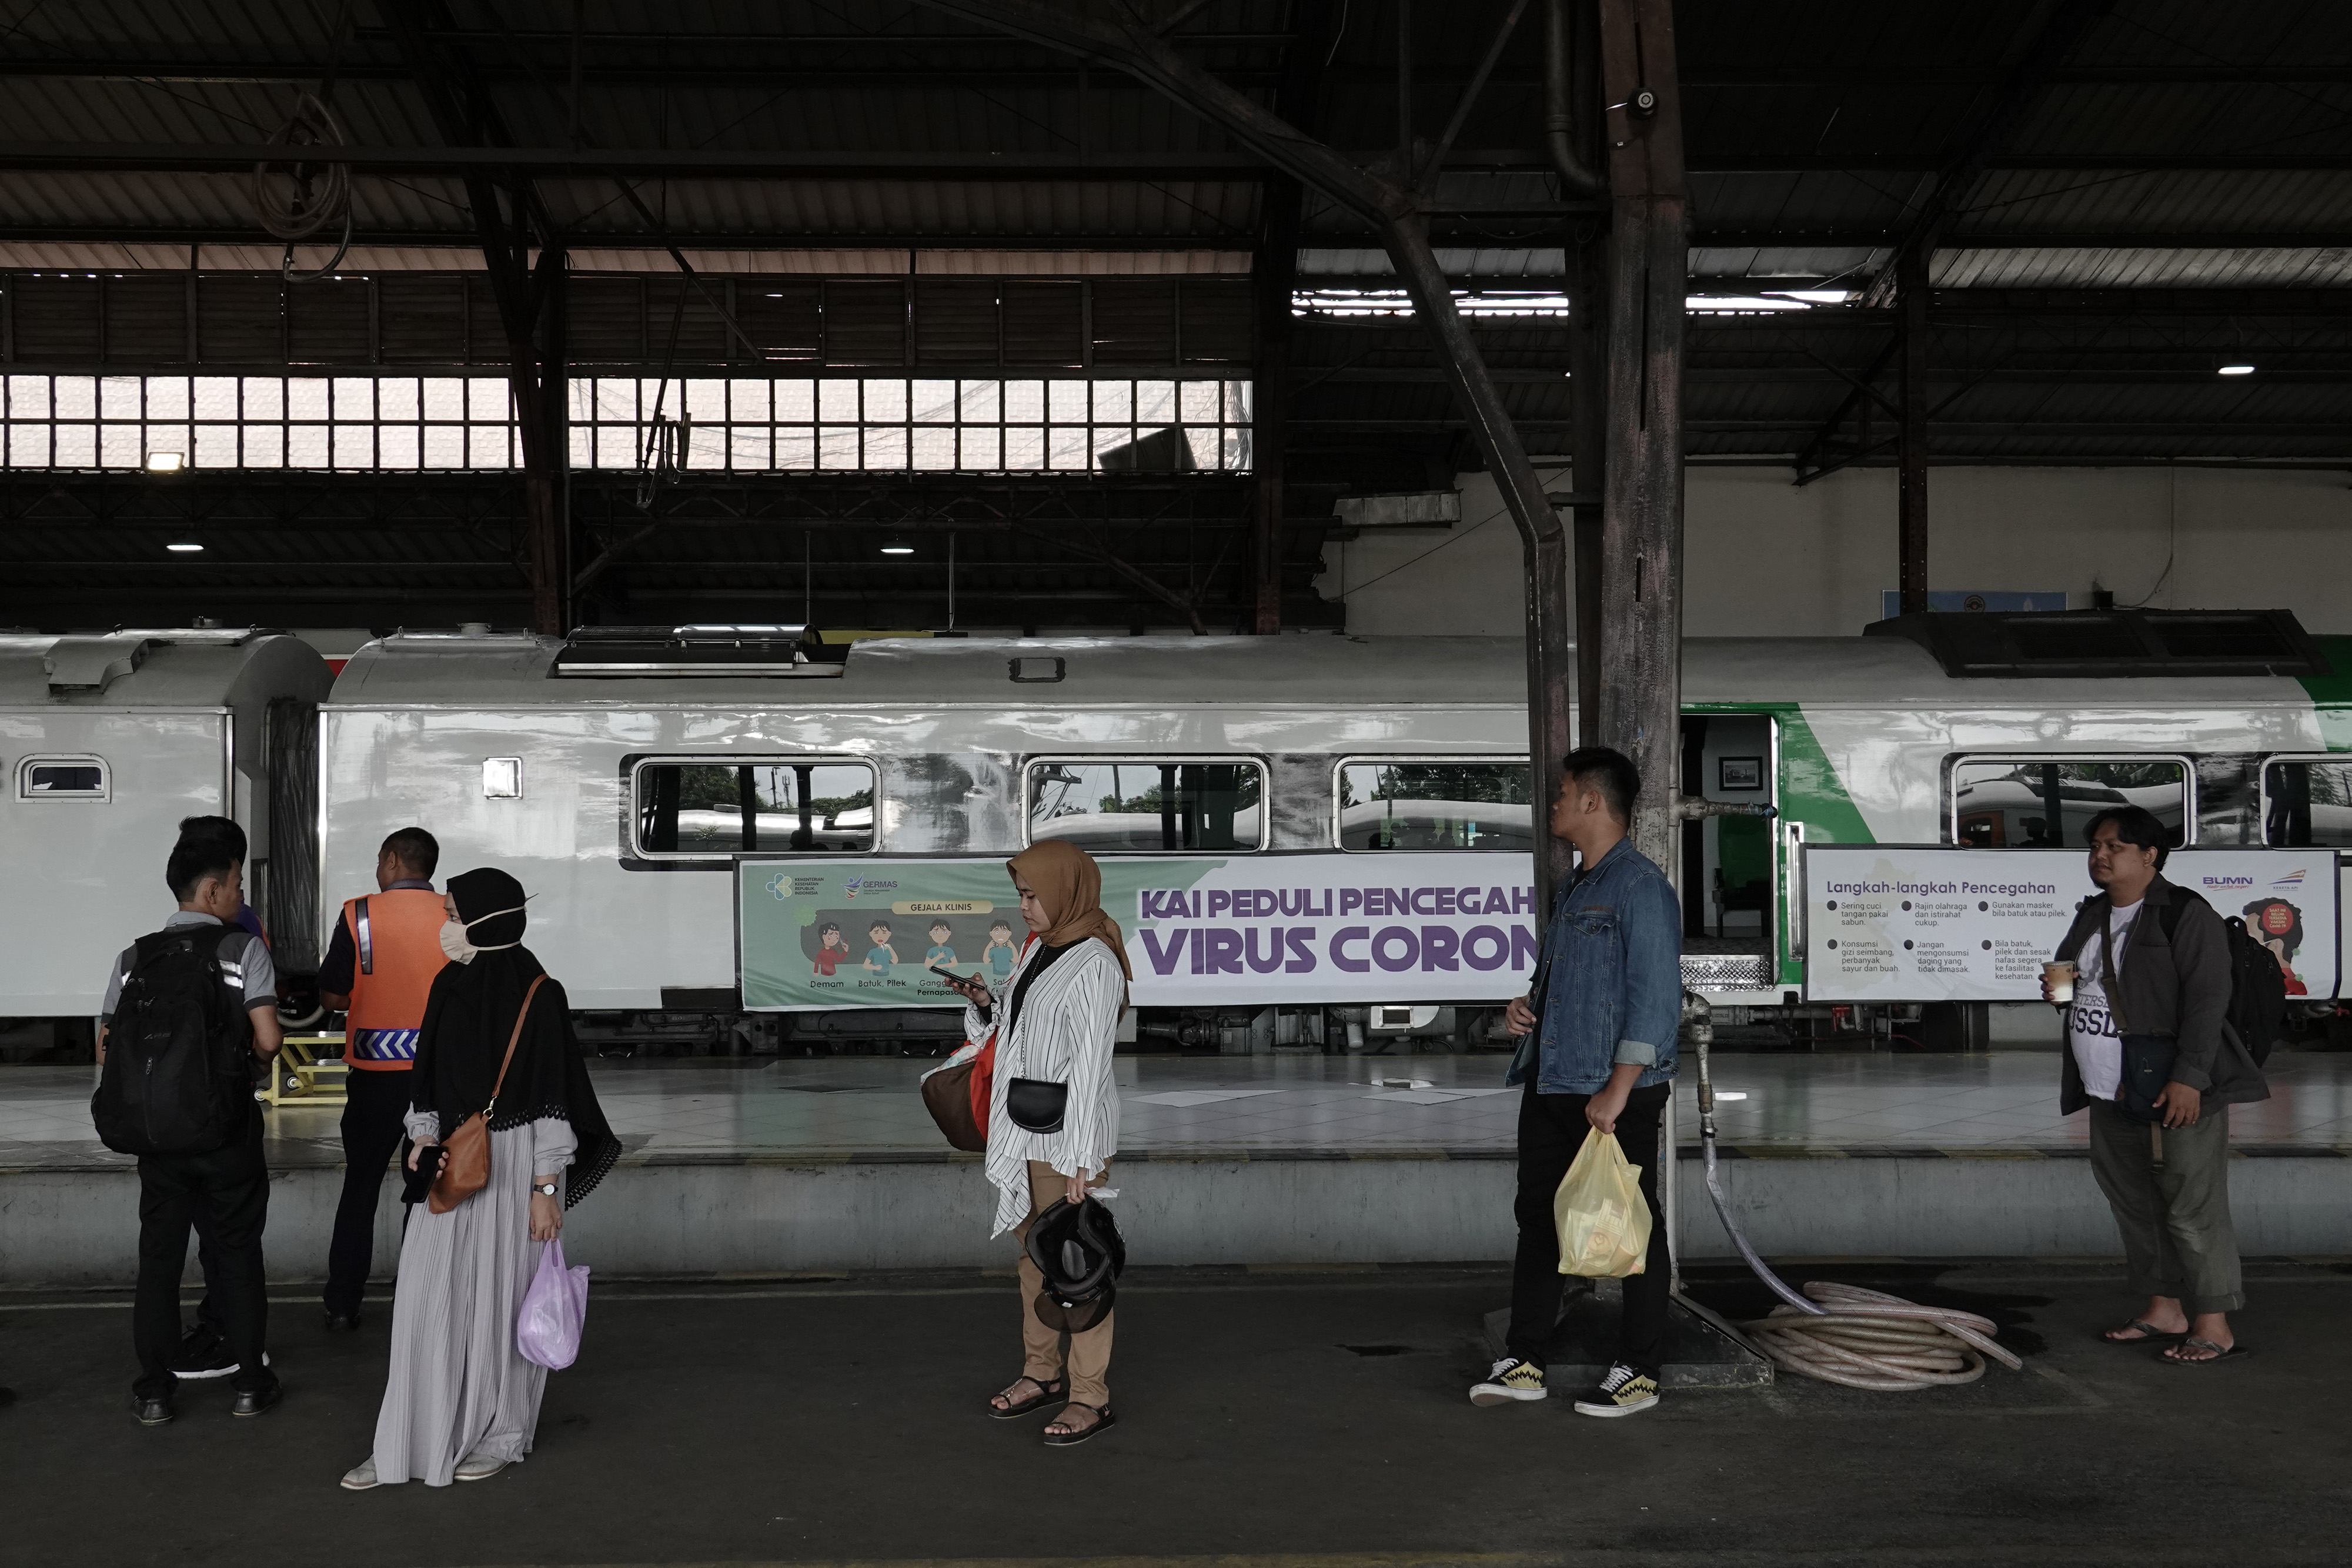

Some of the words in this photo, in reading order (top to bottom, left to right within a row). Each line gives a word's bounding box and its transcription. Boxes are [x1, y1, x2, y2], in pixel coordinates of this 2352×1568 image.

[1828, 881, 1956, 896] Langkah-langkah
[1962, 882, 2054, 896] Pencegahan
[1142, 891, 1200, 918] KAI
[1208, 889, 1332, 917] PEDULI
[1915, 902, 1933, 911] Rajin
[1140, 927, 1316, 975] VIRUS
[1918, 958, 1942, 966] daging
